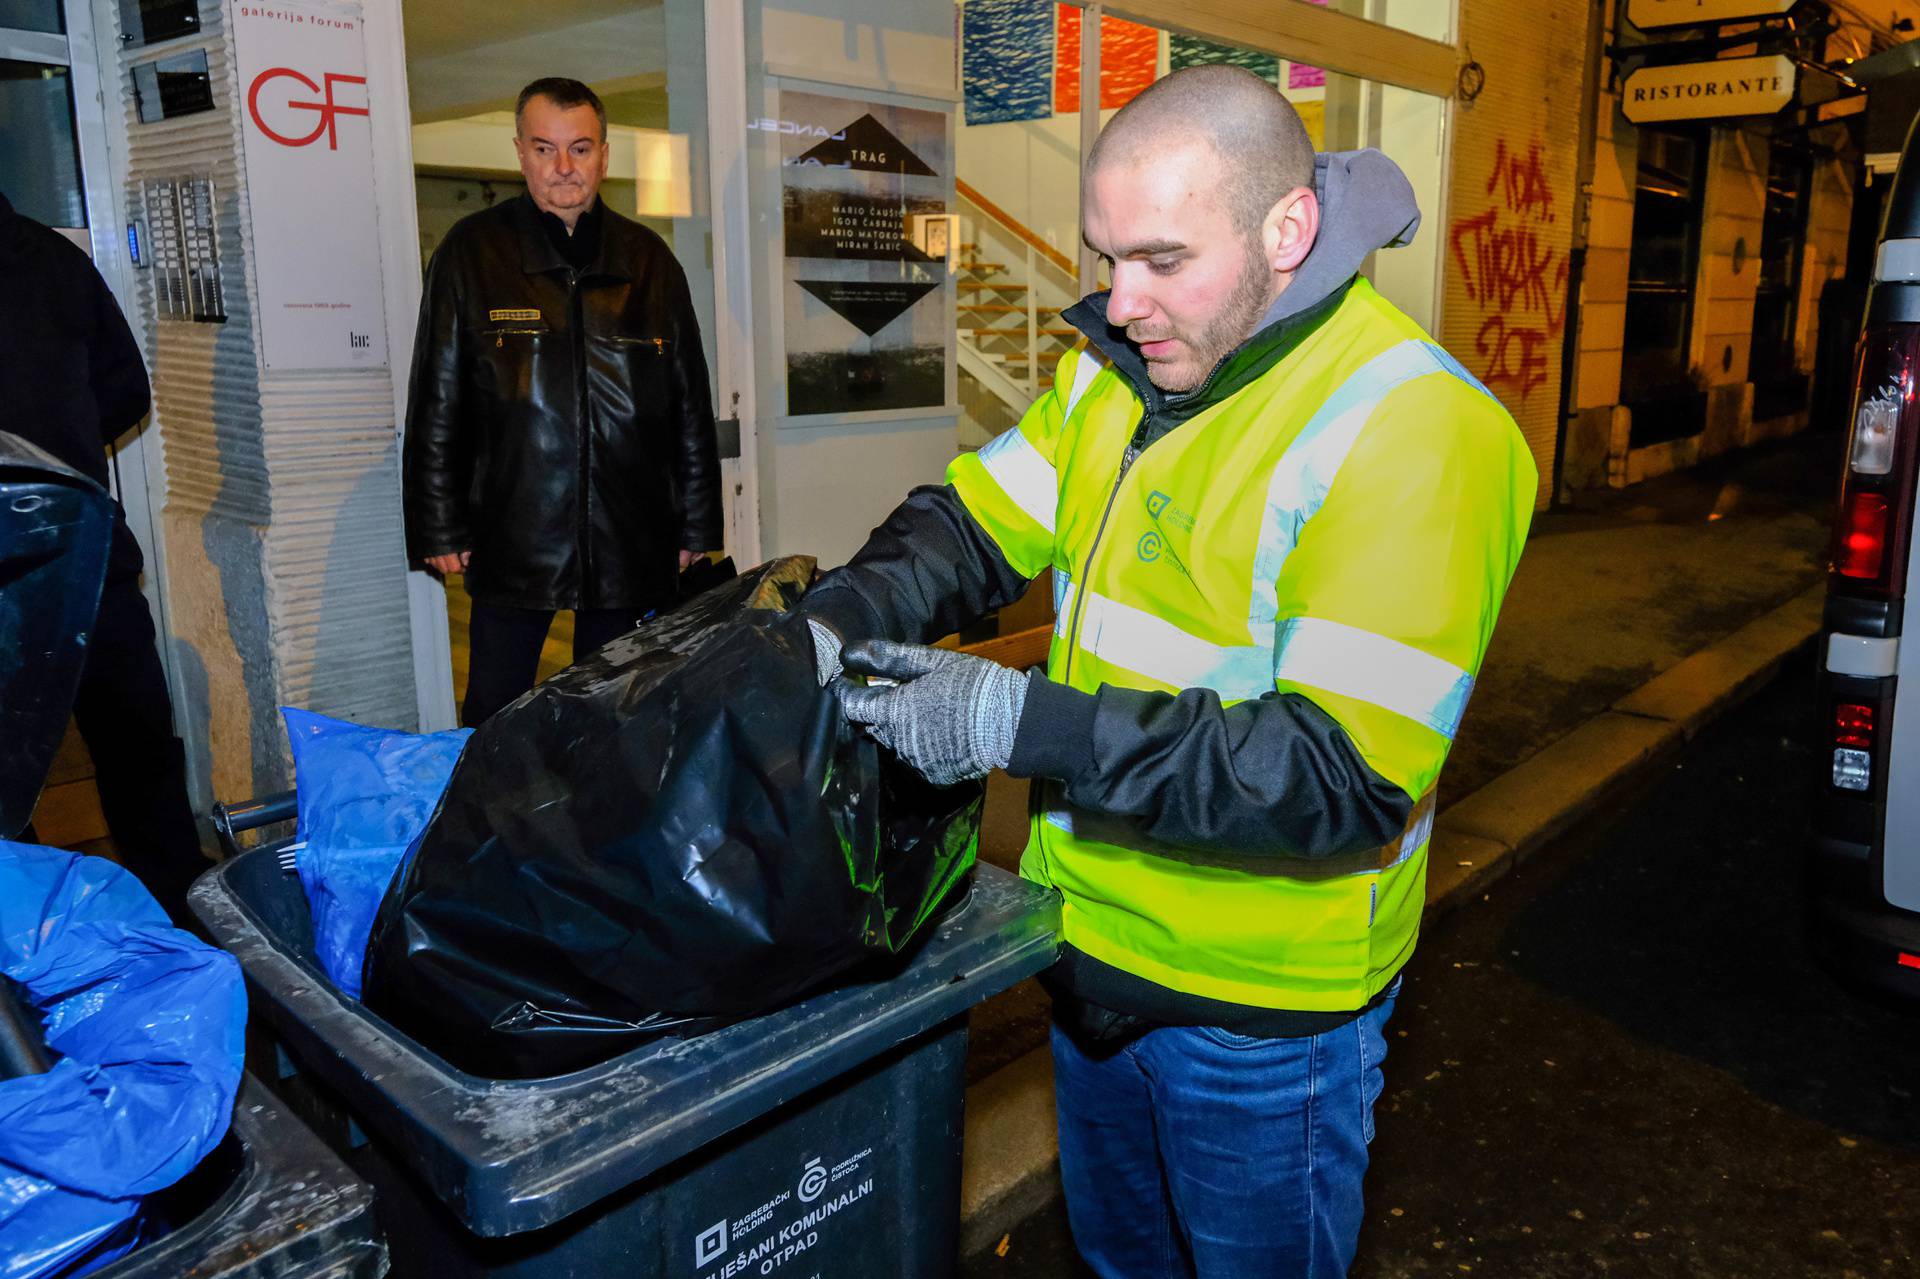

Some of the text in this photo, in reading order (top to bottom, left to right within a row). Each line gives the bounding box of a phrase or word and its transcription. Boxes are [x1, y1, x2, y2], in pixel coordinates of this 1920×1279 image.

[241, 8, 355, 30] galerija forum
[1634, 76, 1783, 102] RISTORANTE
[247, 67, 369, 151] GF
[851, 150, 886, 164] TRAG
[832, 206, 865, 216] MARIO
[833, 216, 857, 226] IGOR
[821, 228, 853, 238] MARIO
[831, 1147, 872, 1174] PODRUŽNICA
[732, 1190, 790, 1232] ZAGREBAČKI
[779, 1178, 873, 1245] KOMUNALNI
[732, 1210, 773, 1241] HOLDING
[760, 1231, 818, 1275] OTPAD
